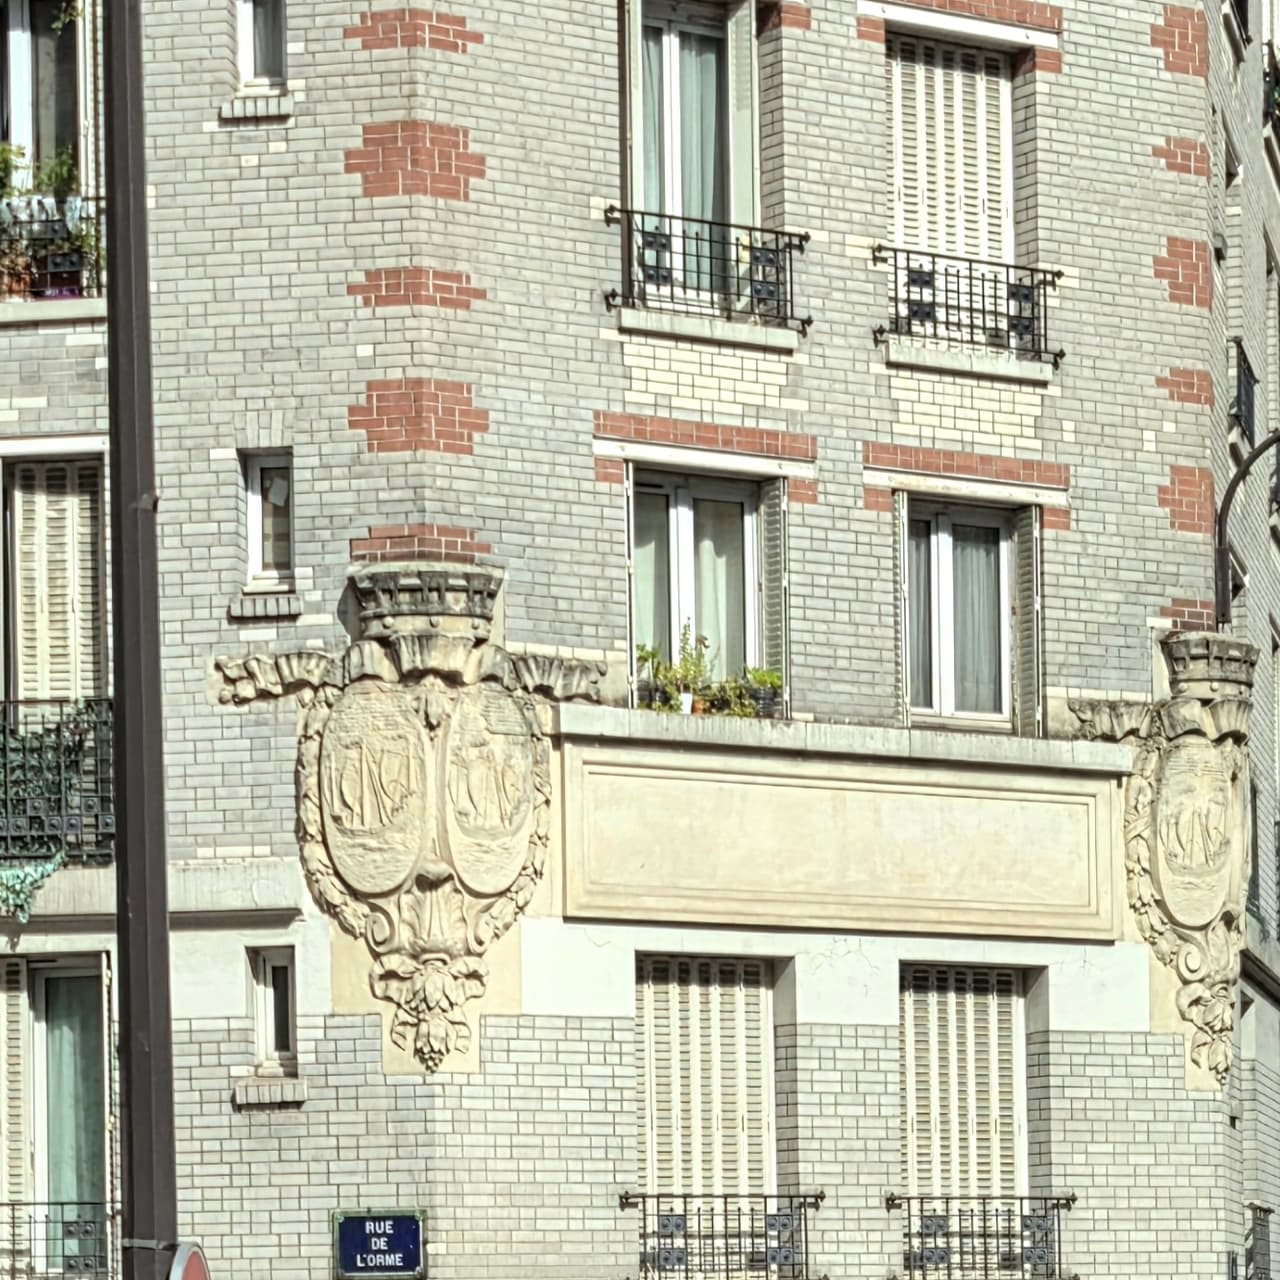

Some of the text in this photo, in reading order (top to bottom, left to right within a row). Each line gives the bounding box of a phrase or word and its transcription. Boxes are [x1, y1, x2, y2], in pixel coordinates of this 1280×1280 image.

[365, 1220, 394, 1234] RUE
[371, 1237, 388, 1250] DE
[356, 1253, 404, 1267] L'ORME
